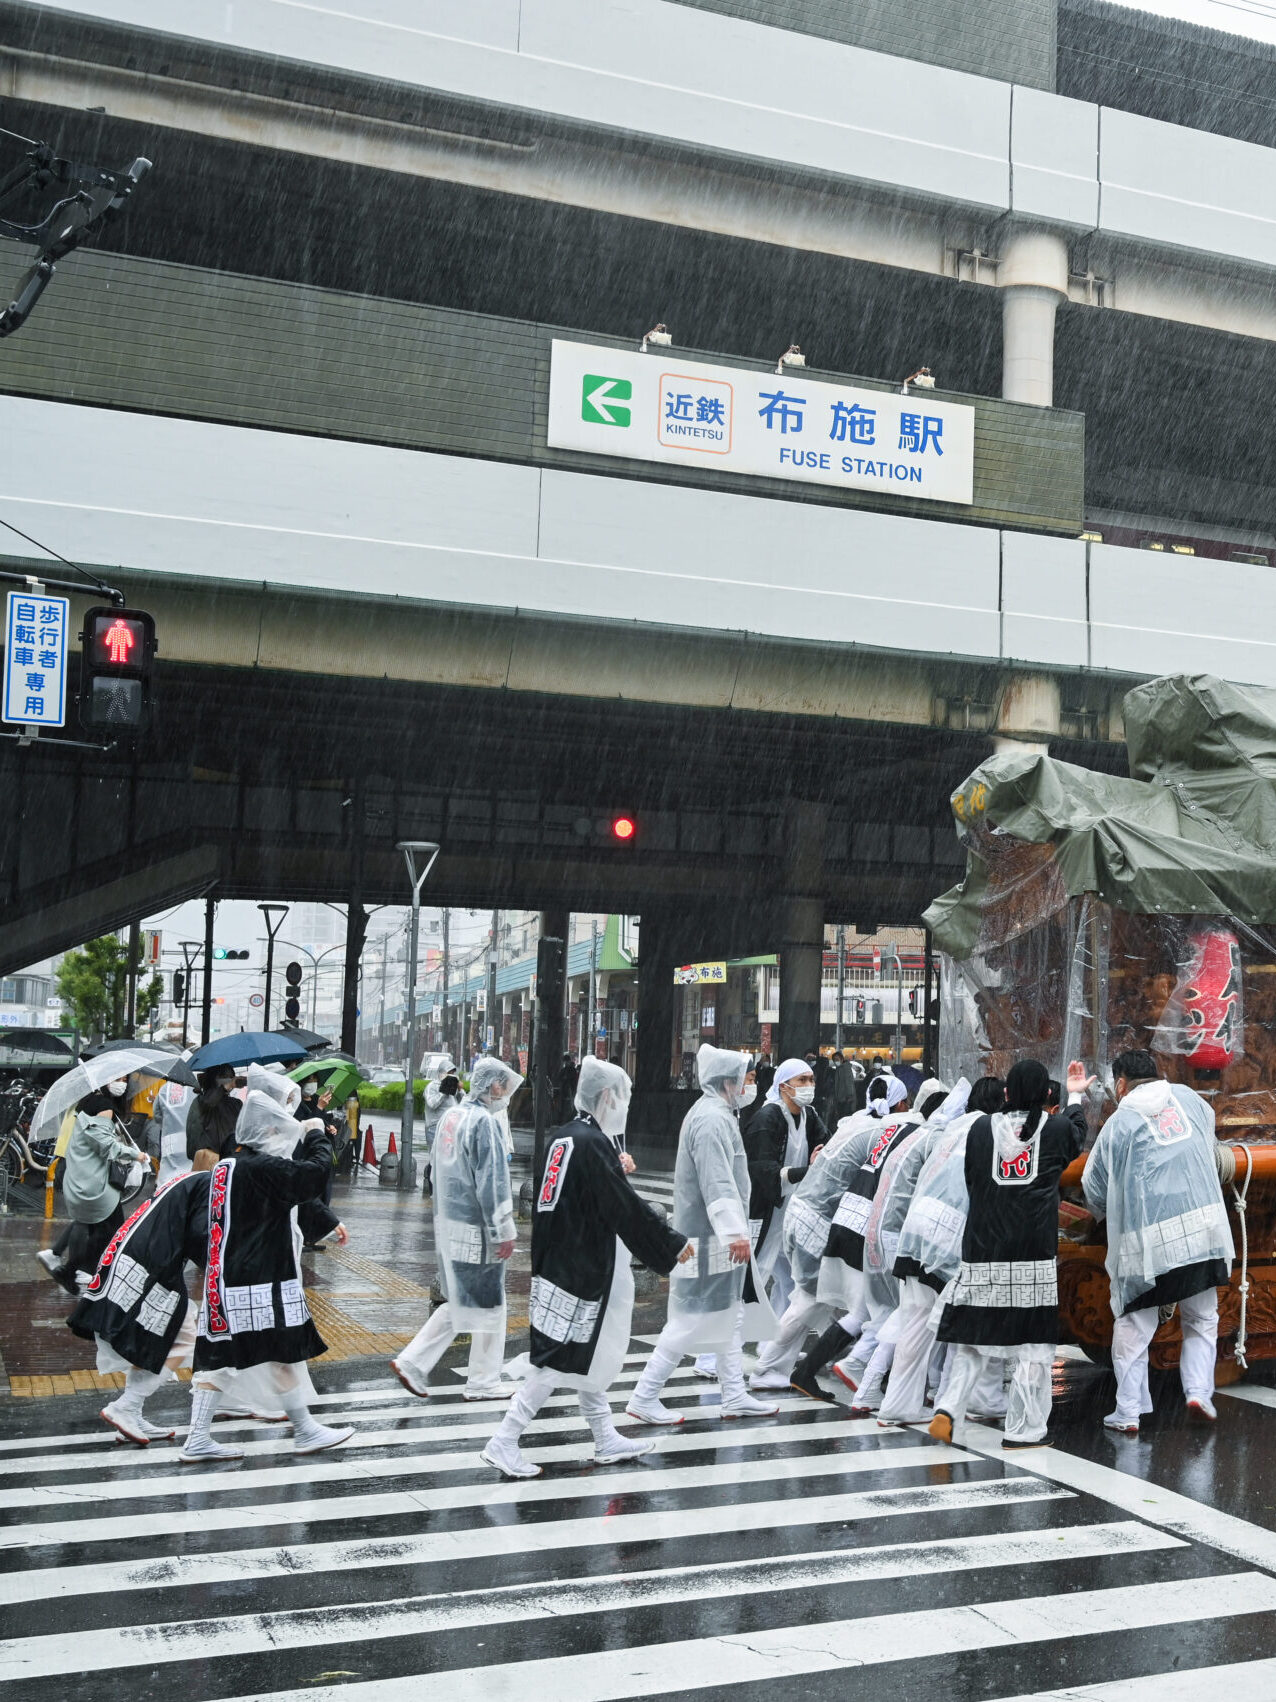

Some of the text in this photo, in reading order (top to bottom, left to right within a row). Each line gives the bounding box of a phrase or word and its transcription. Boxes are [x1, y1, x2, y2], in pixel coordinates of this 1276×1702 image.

[665, 391, 725, 426] 近鉄
[758, 390, 944, 457] 布施駅
[666, 424, 724, 442] KINTETSU
[779, 448, 923, 483] FUSE STATION
[13, 603, 36, 667] 自転車
[38, 605, 60, 668] 歩行者
[24, 672, 46, 716] 専用
[700, 967, 723, 979] 布施
